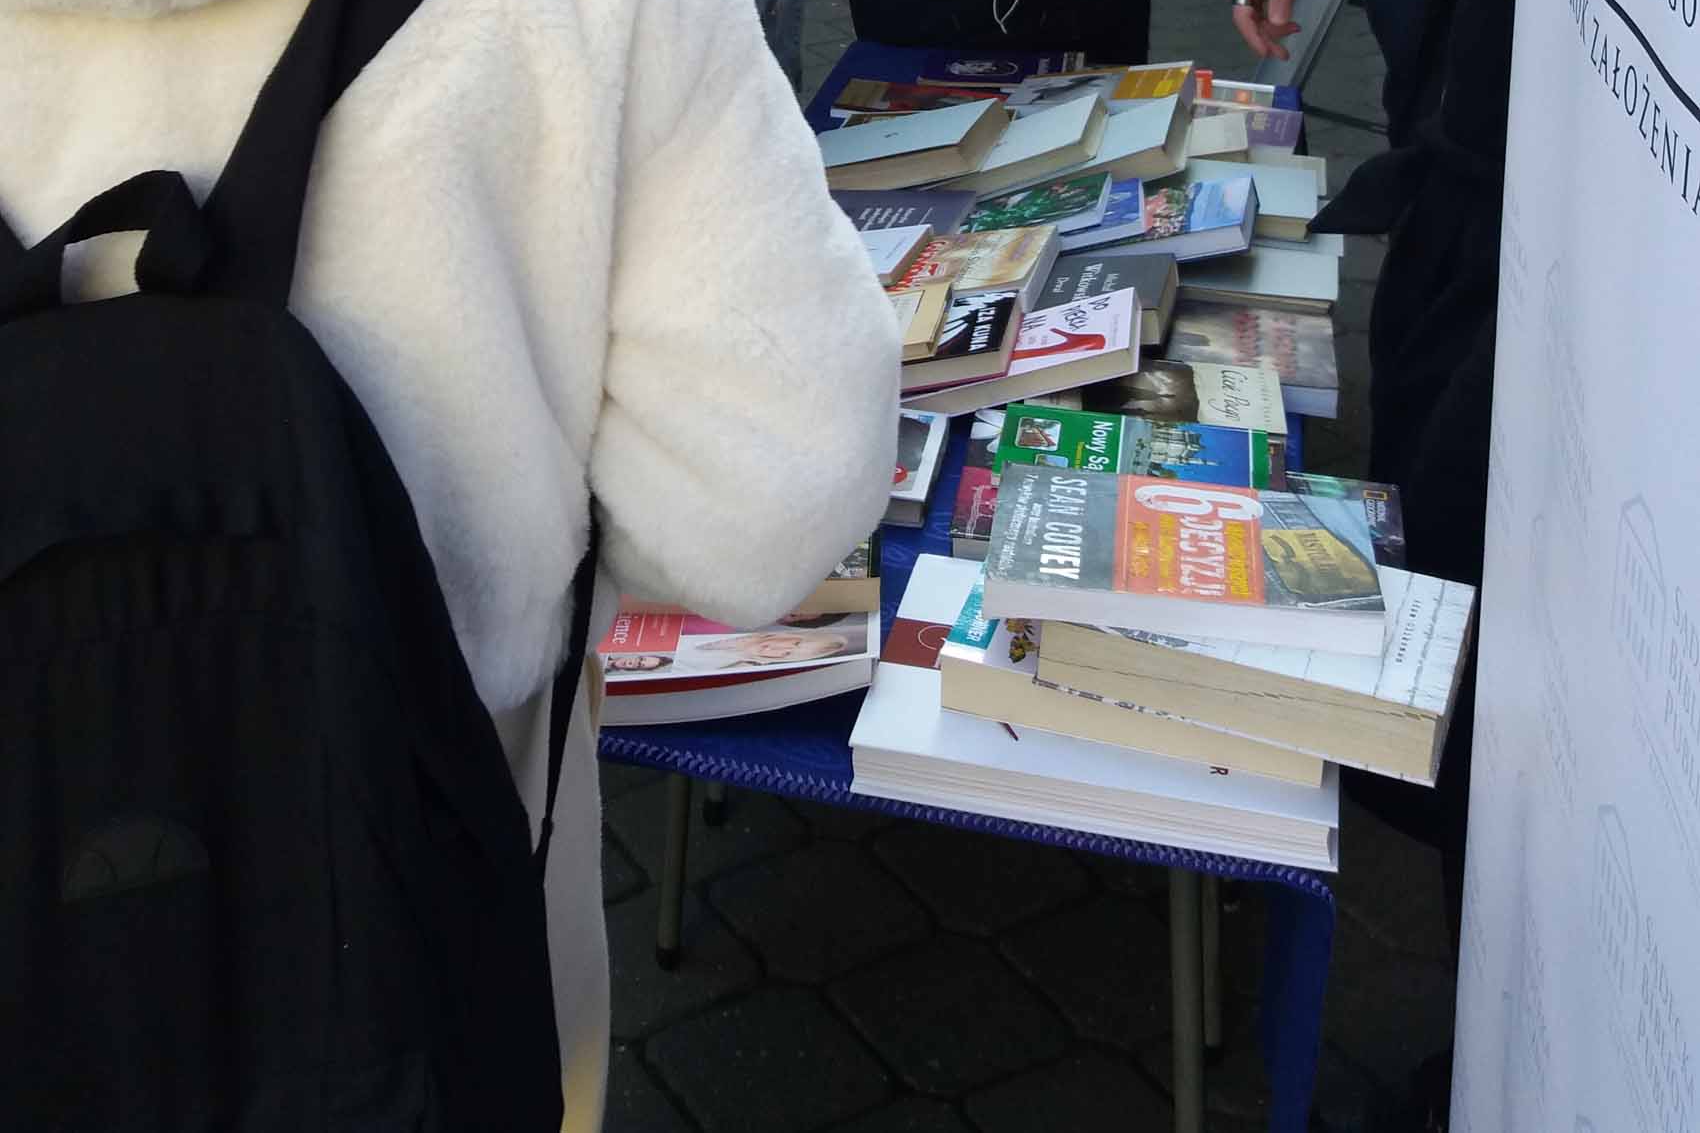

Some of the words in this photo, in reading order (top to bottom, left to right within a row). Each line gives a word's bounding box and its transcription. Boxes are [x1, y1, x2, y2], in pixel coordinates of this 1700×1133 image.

[968, 324, 992, 352] KUNA
[1085, 420, 1113, 455] Nowy
[1048, 476, 1088, 517] SEAN
[1039, 521, 1084, 580] COVEY
